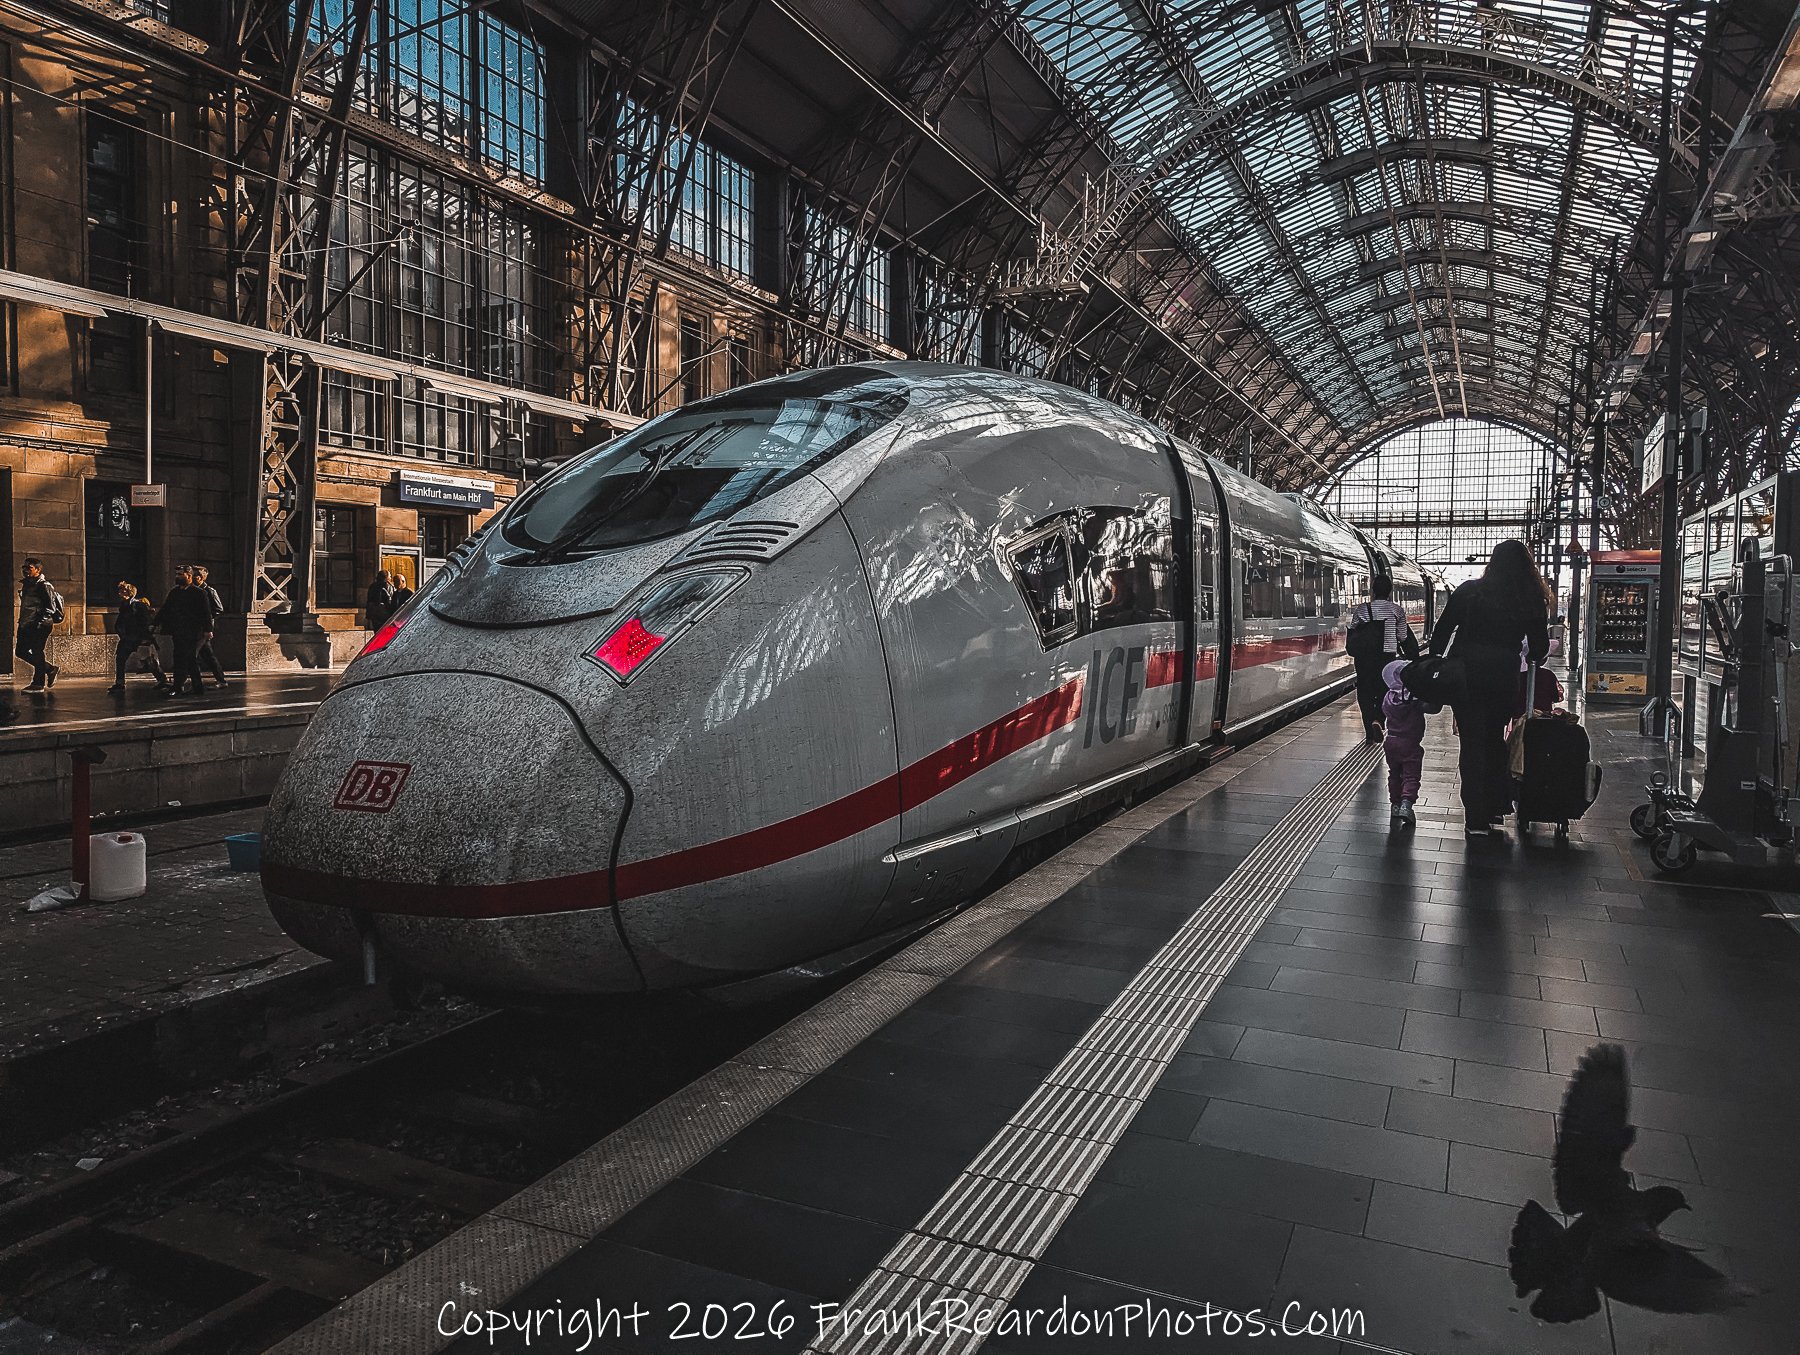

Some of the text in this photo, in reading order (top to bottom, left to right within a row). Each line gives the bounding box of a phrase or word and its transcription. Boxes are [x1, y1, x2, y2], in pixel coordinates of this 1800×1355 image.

[405, 484, 482, 503] Frankfurt am Main Hbf
[1083, 646, 1145, 749] ICE
[342, 768, 398, 804] DB
